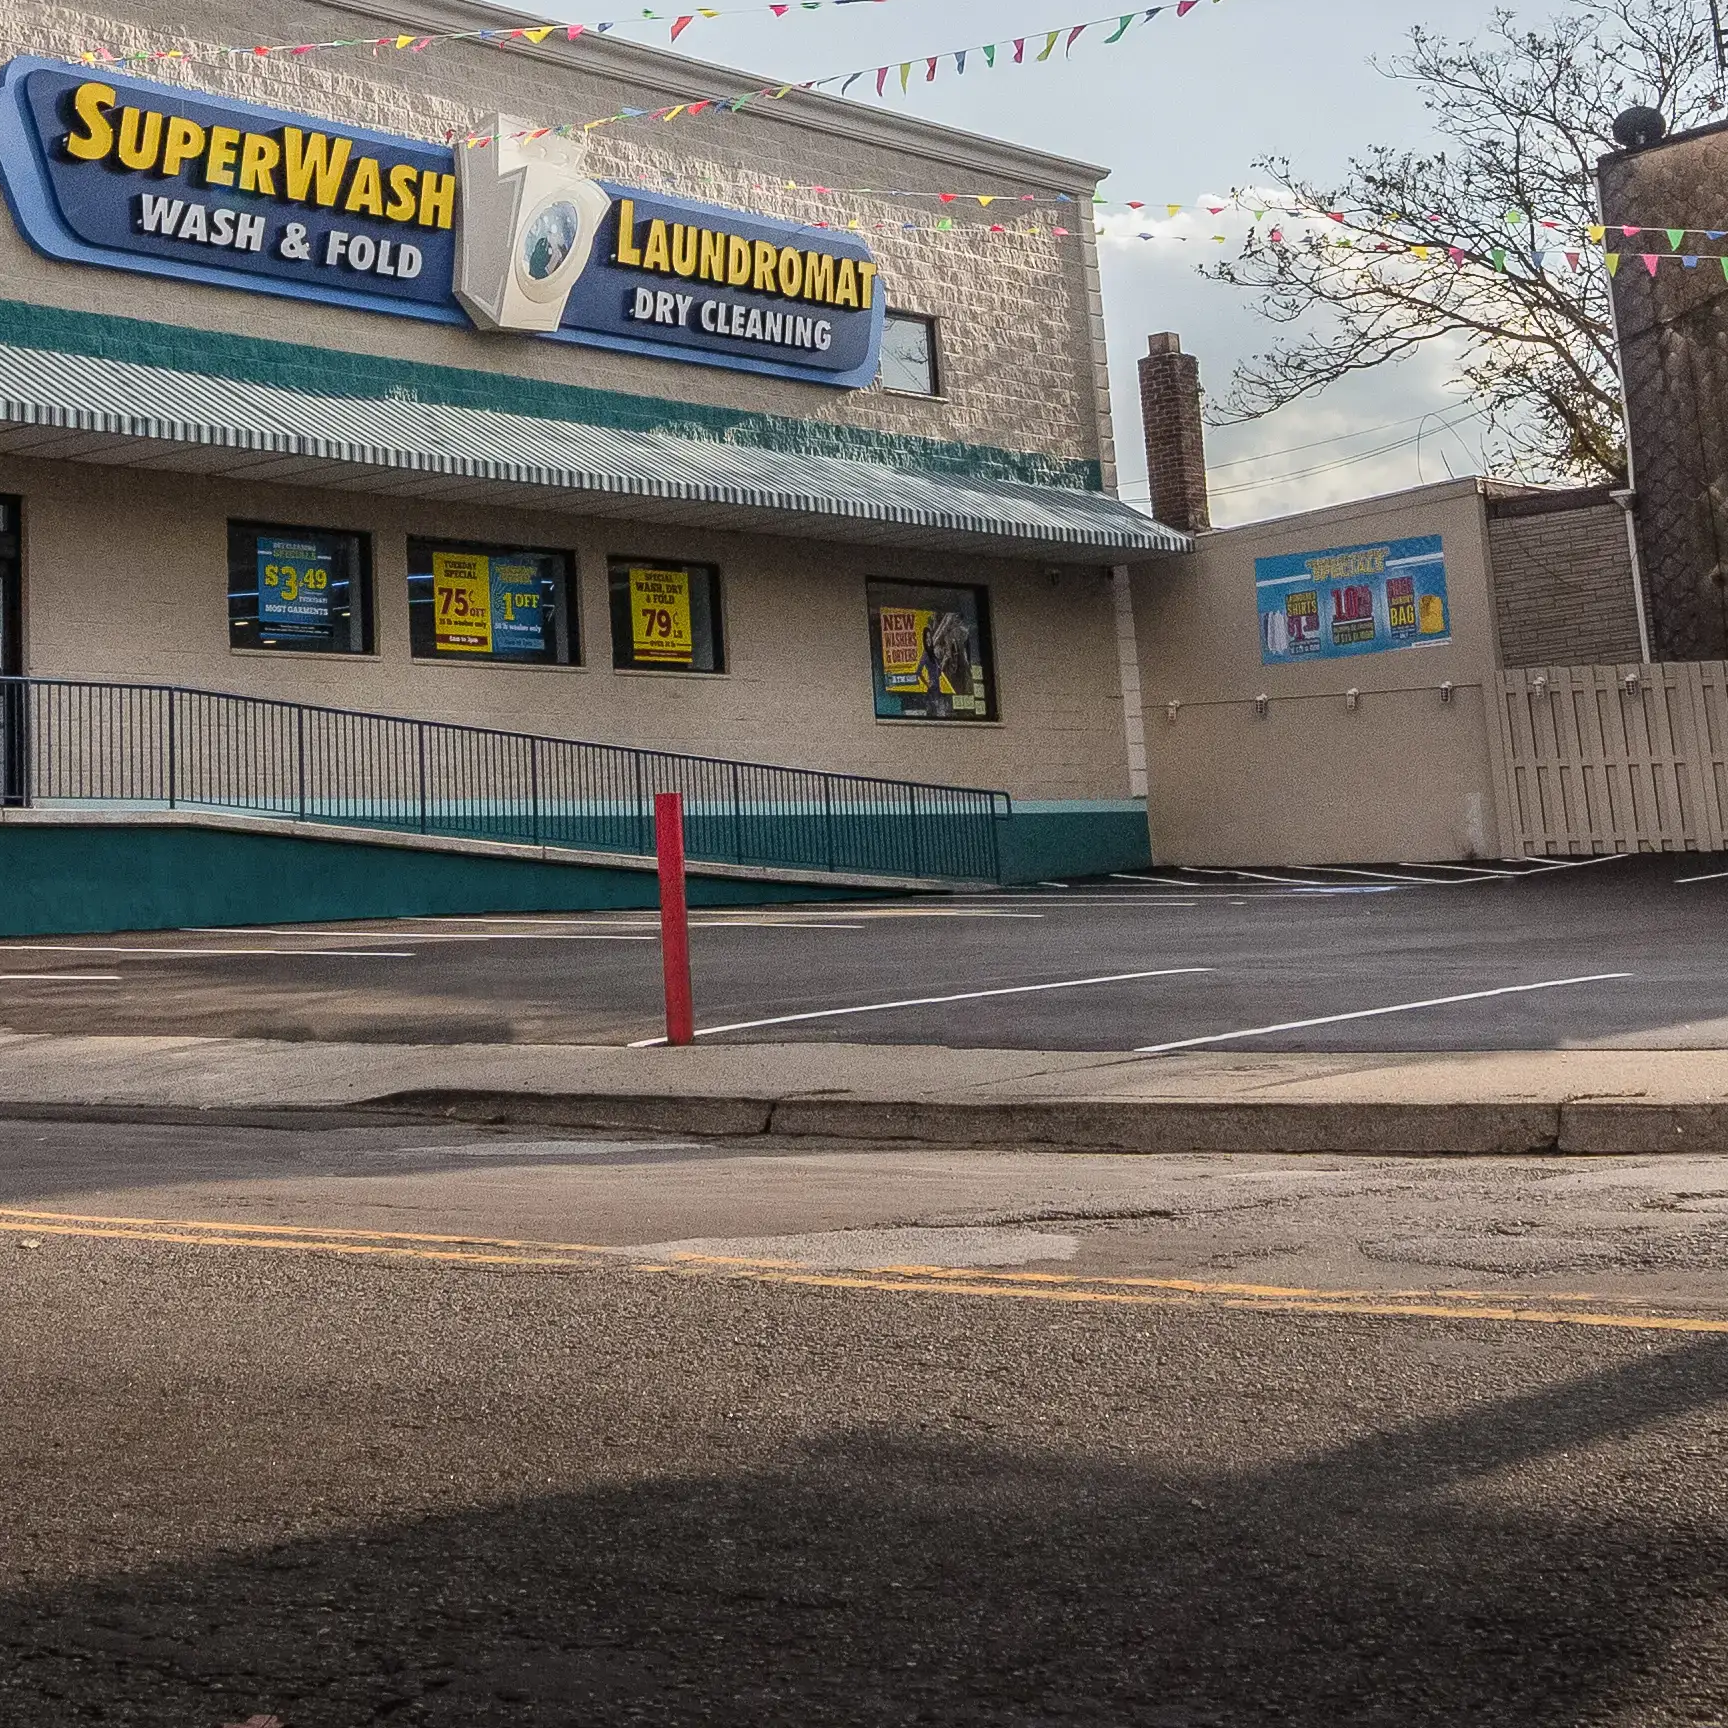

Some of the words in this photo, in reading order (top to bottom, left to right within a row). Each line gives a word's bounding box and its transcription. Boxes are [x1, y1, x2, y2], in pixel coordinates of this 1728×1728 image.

[141, 194, 266, 252] WASH
[280, 222, 312, 260] &
[325, 230, 423, 279] FOLD
[617, 198, 877, 310] LAUNDROMAT
[633, 286, 694, 327] DRY
[700, 299, 833, 352] CLEANING
[264, 564, 328, 601] $3.49
[443, 570, 478, 580] SPECIAL
[666, 583, 684, 594] DRY
[515, 594, 540, 609] OFF
[653, 594, 675, 605] FOLD
[265, 604, 287, 613] MOST
[287, 605, 329, 616] GARMENTS
[469, 608, 486, 618] OFF
[1287, 600, 1318, 617] SHIRTS
[1390, 606, 1415, 627] BAG
[882, 614, 915, 632] NEW
[884, 632, 918, 648] WASHERS
